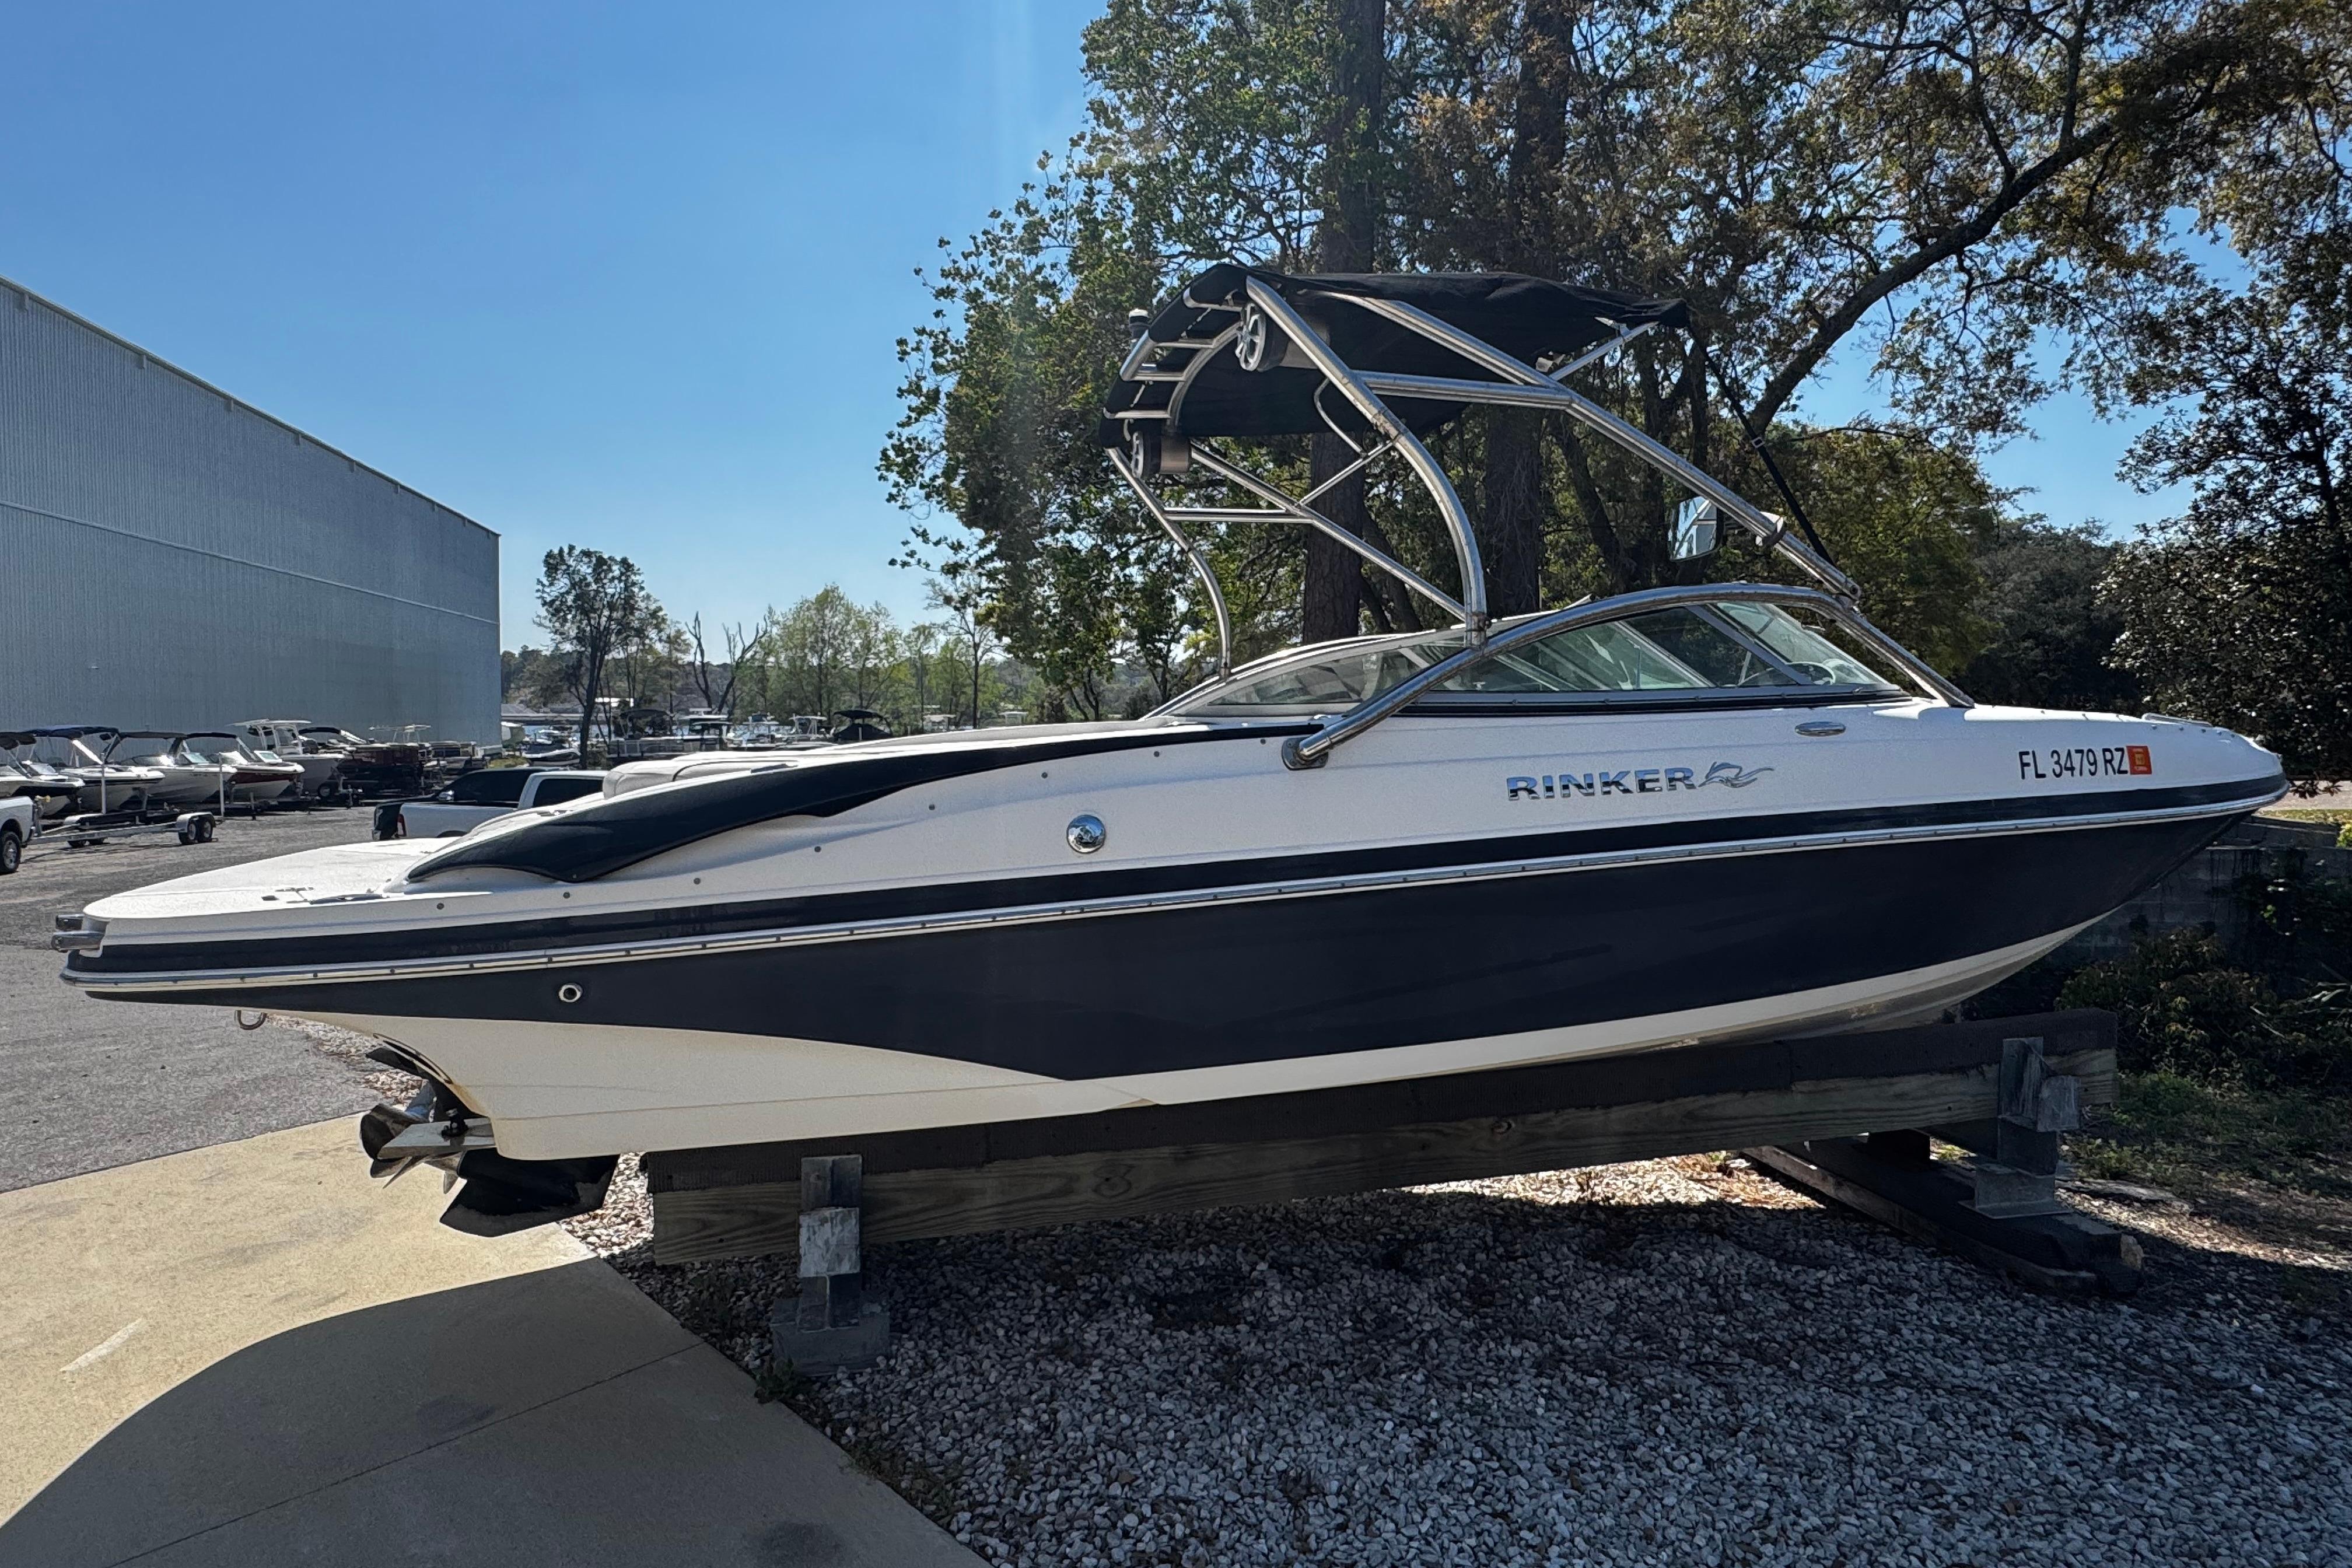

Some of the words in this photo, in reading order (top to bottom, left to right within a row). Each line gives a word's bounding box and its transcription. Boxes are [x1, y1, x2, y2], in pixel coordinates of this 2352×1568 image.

[2019, 750, 2046, 779] FL
[2050, 748, 2098, 778] 3479
[2102, 747, 2128, 775] RZ
[1506, 767, 1696, 801] RINKER
